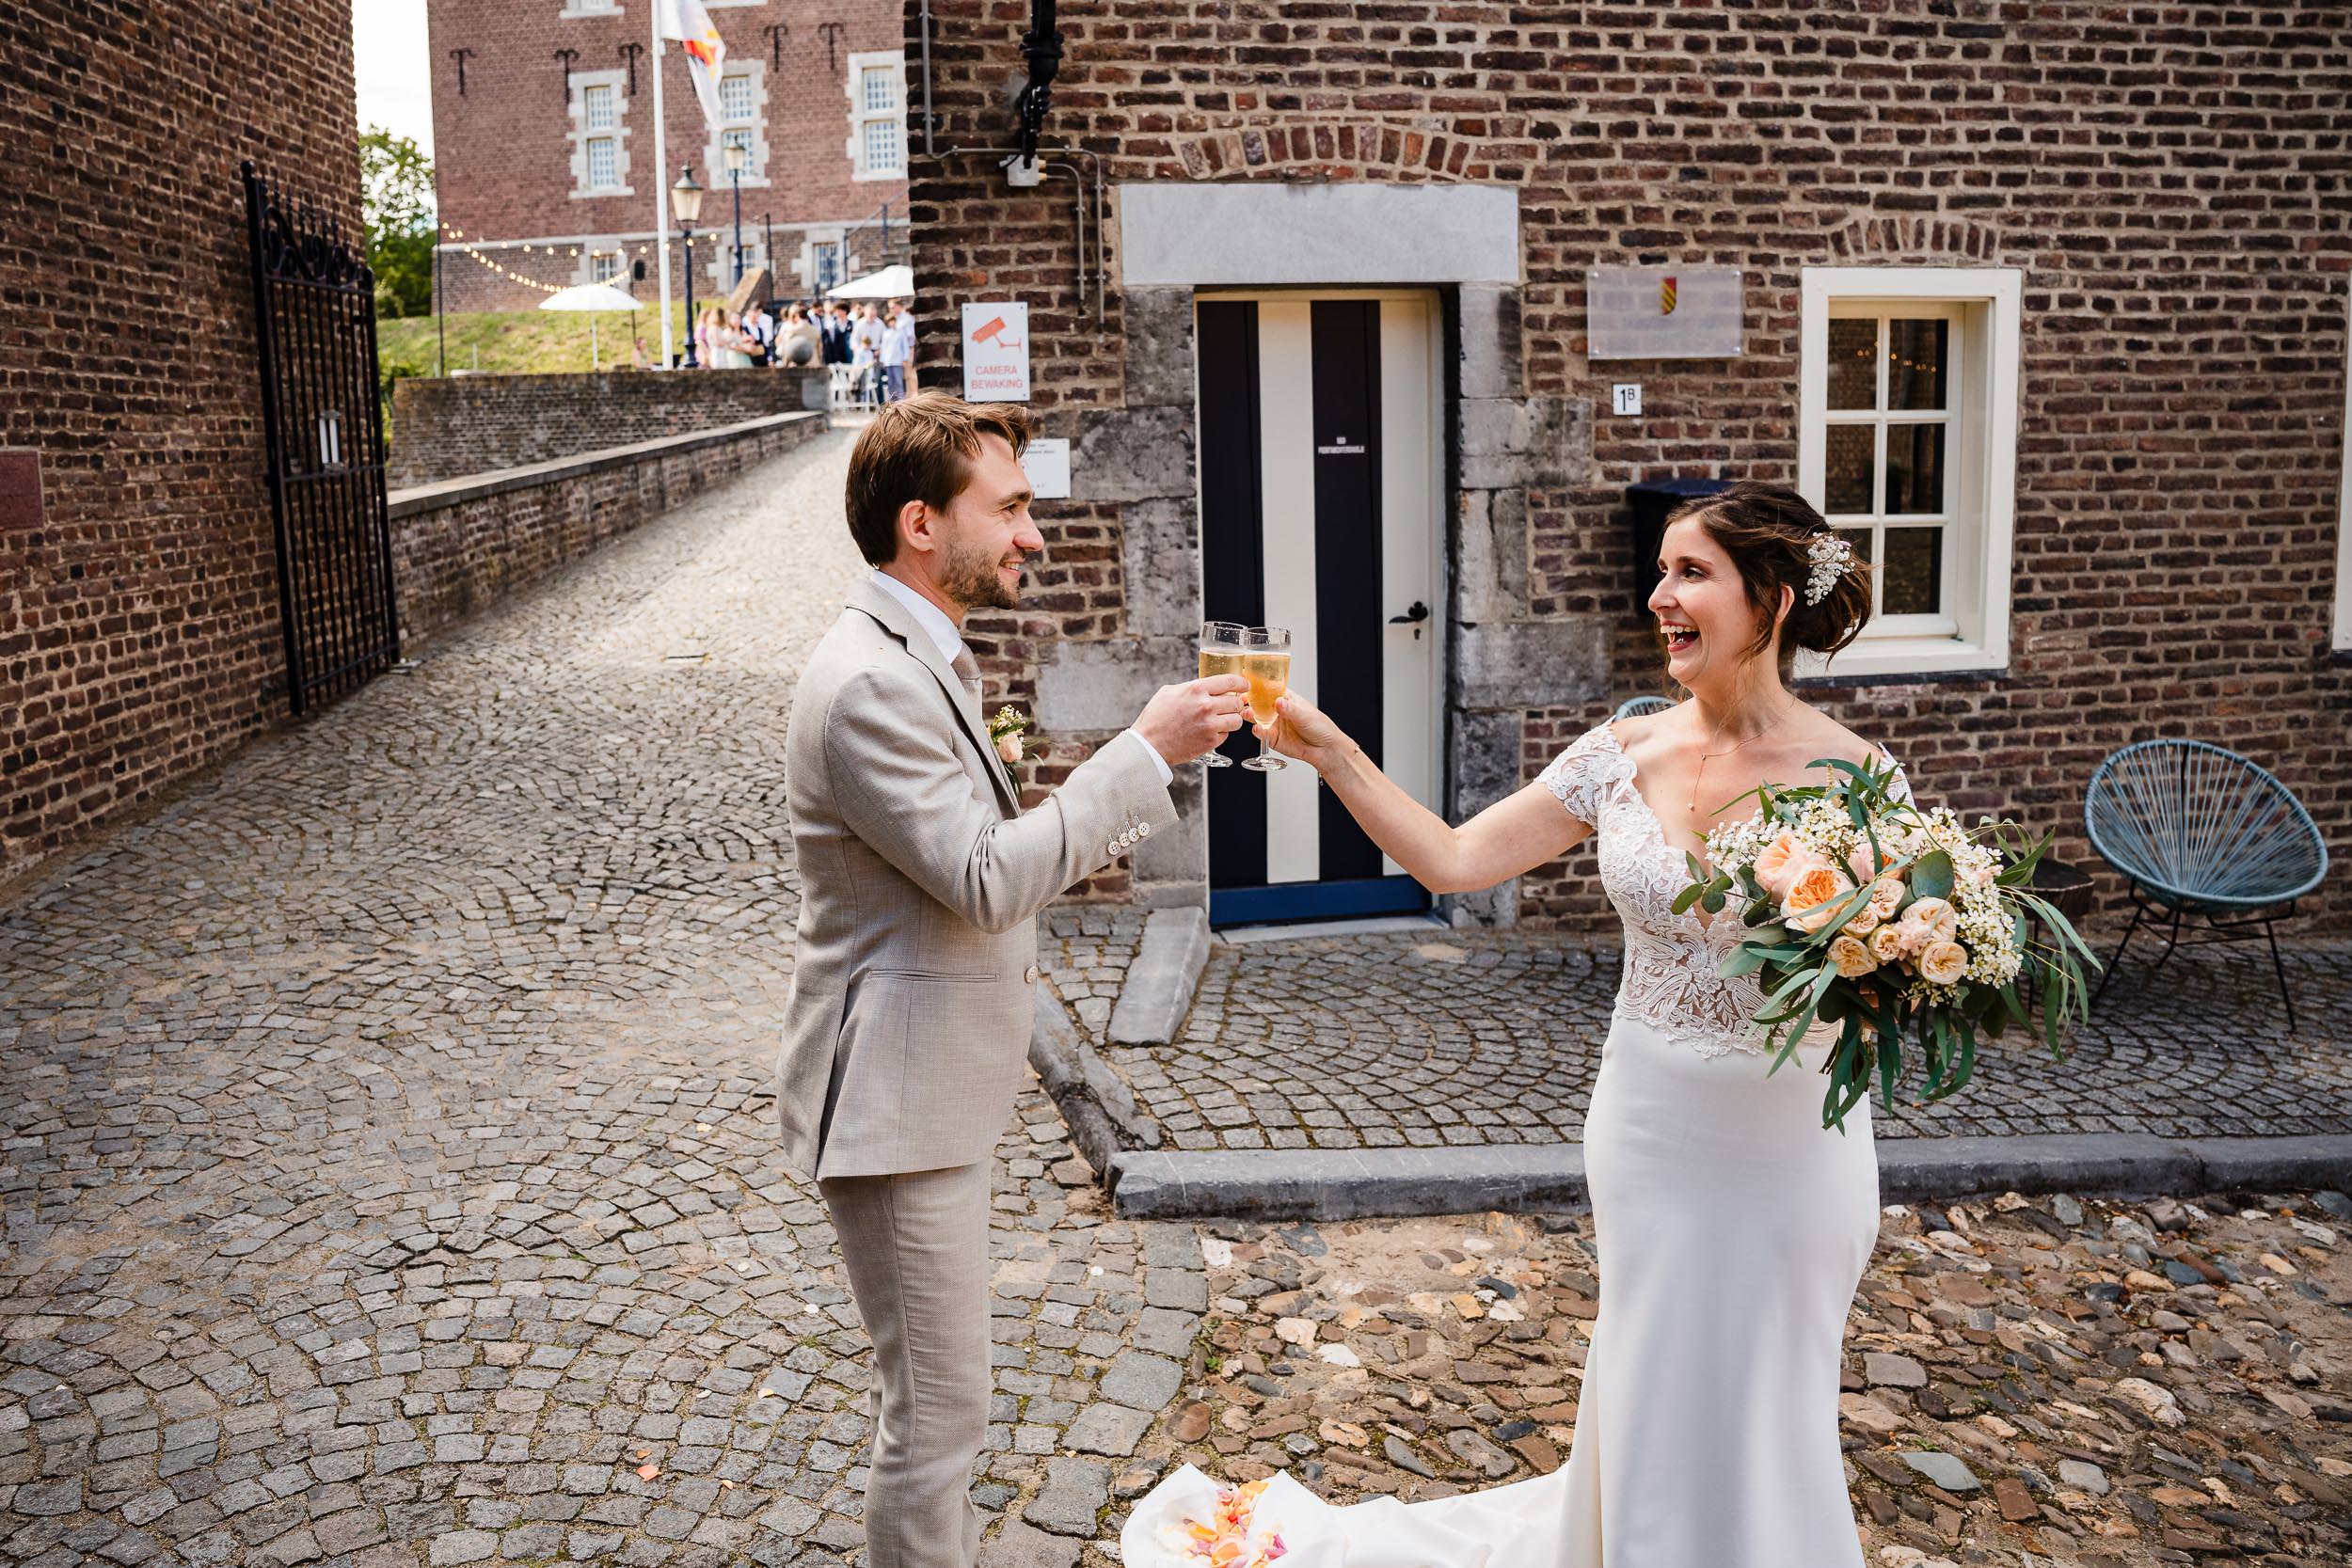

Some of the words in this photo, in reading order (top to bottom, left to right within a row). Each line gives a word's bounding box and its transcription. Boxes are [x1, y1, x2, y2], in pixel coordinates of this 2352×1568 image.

[976, 365, 1018, 375] CAMERA
[971, 379, 1024, 389] BEWAKING
[1620, 388, 1635, 412] 1B
